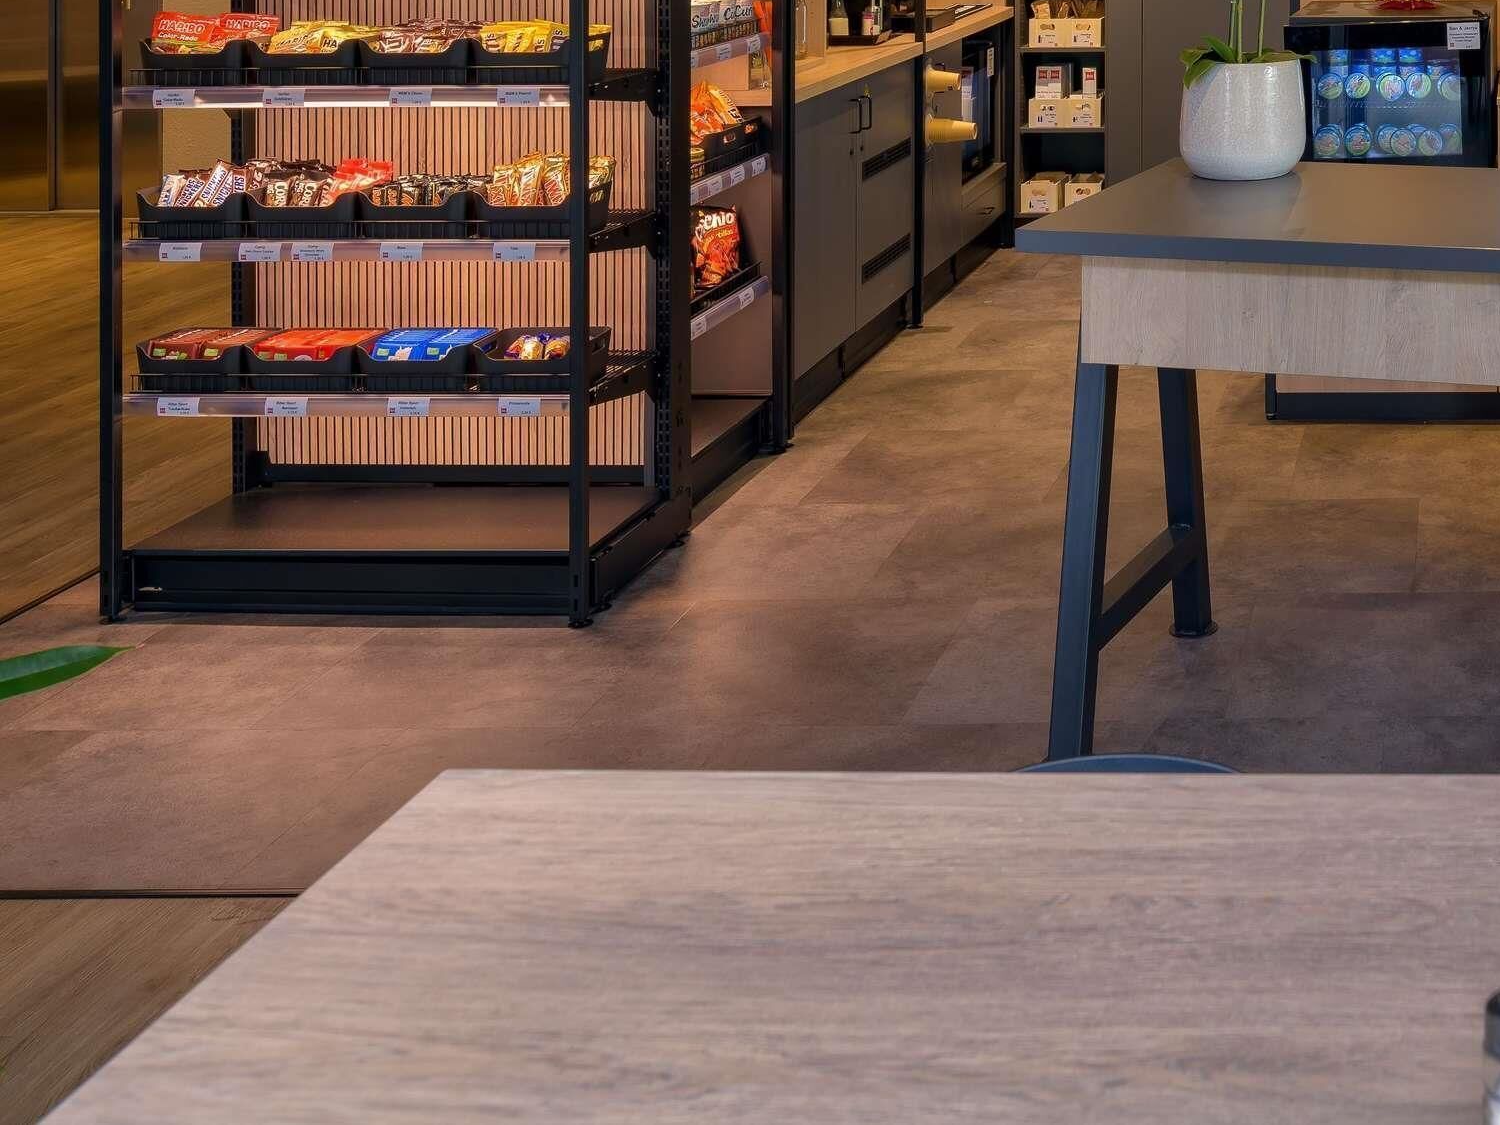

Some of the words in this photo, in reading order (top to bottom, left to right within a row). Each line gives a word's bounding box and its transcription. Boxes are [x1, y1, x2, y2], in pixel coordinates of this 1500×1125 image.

[159, 19, 206, 35] HARIBO
[225, 19, 271, 32] HARIBO
[158, 31, 199, 42] Color-Rado
[203, 169, 227, 203] SNICKERS
